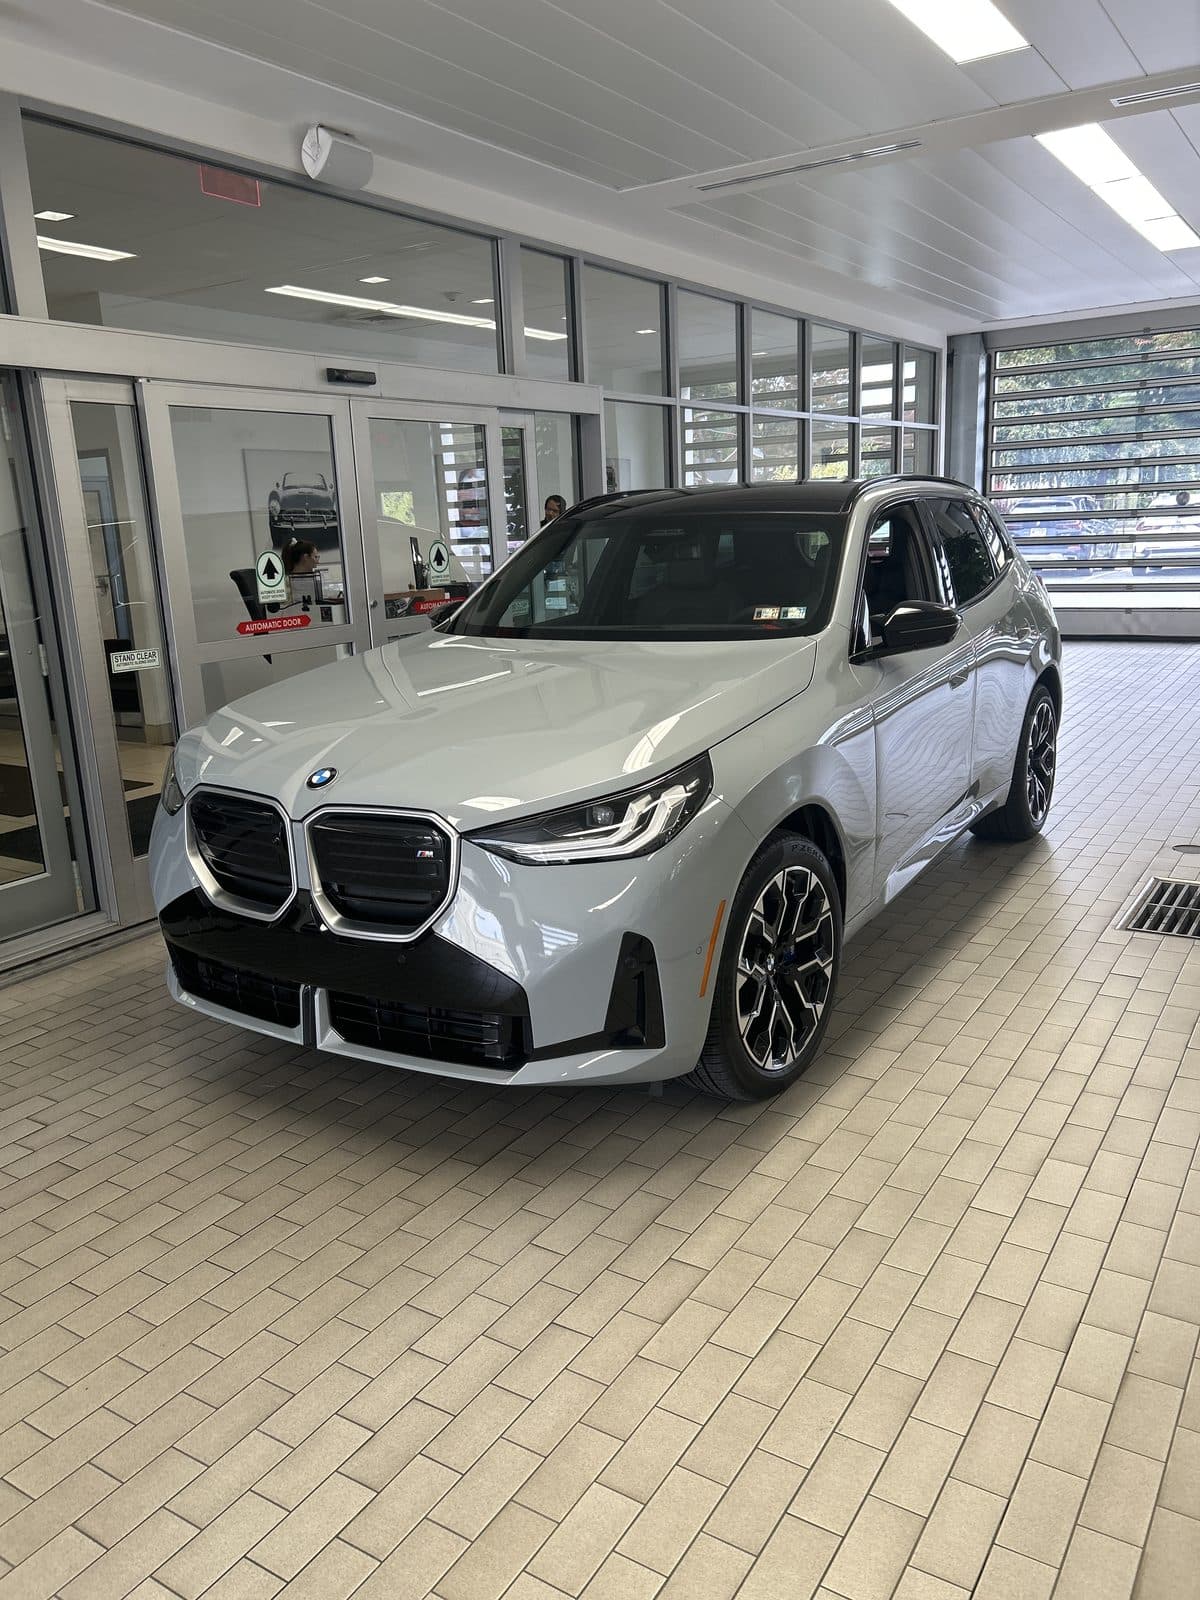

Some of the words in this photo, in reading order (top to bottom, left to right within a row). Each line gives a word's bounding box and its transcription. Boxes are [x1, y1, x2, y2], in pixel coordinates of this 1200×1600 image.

[245, 621, 282, 631] AUTOMATIC
[283, 618, 302, 627] DOOR
[115, 654, 136, 662] STAND
[137, 651, 157, 660] CLEAR
